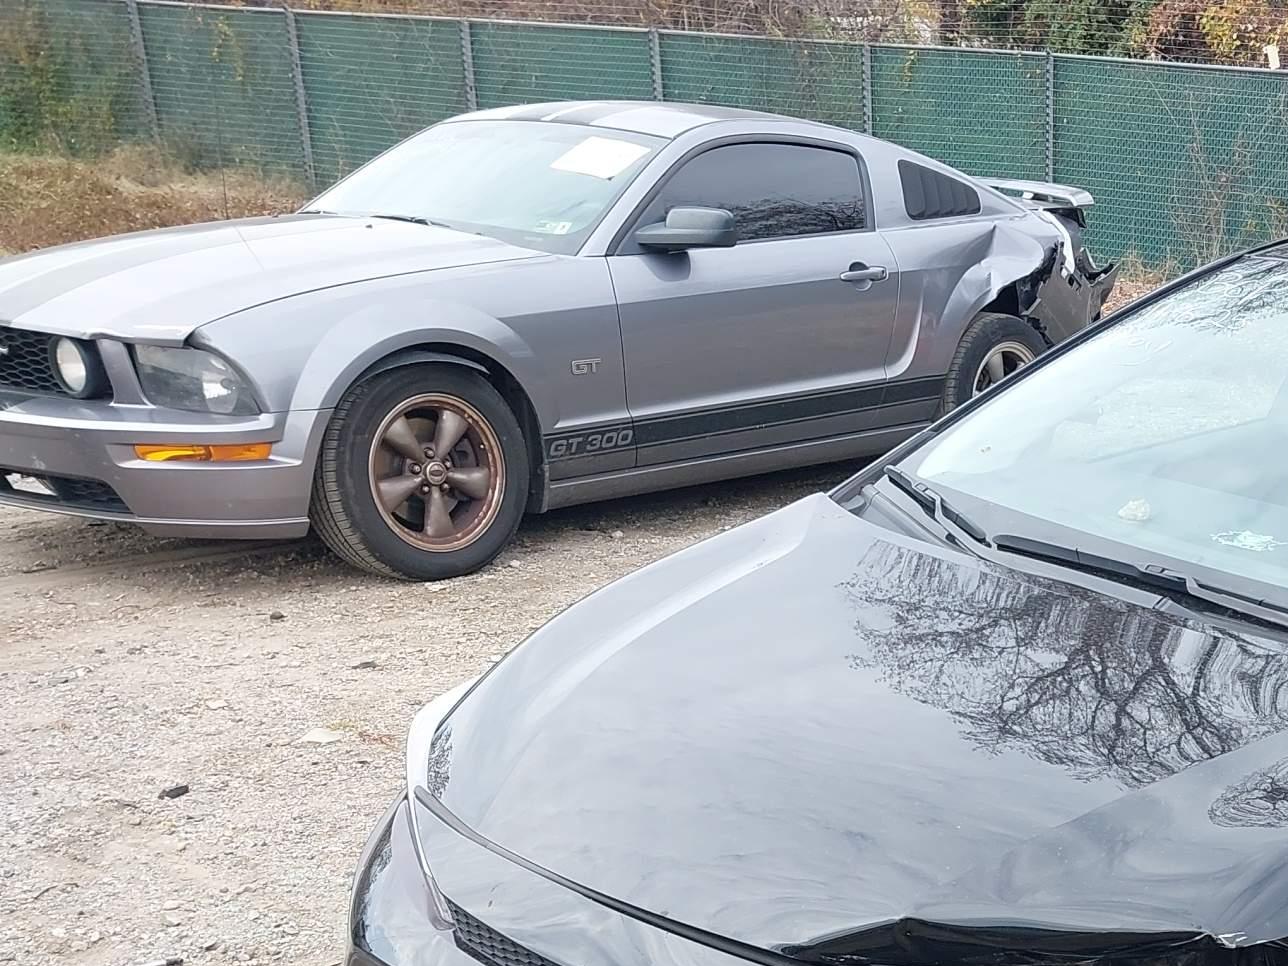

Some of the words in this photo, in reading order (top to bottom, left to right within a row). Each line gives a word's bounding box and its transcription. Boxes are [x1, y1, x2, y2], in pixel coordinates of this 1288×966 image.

[571, 358, 601, 376] GT
[549, 437, 583, 457] GT
[586, 429, 634, 452] 300
